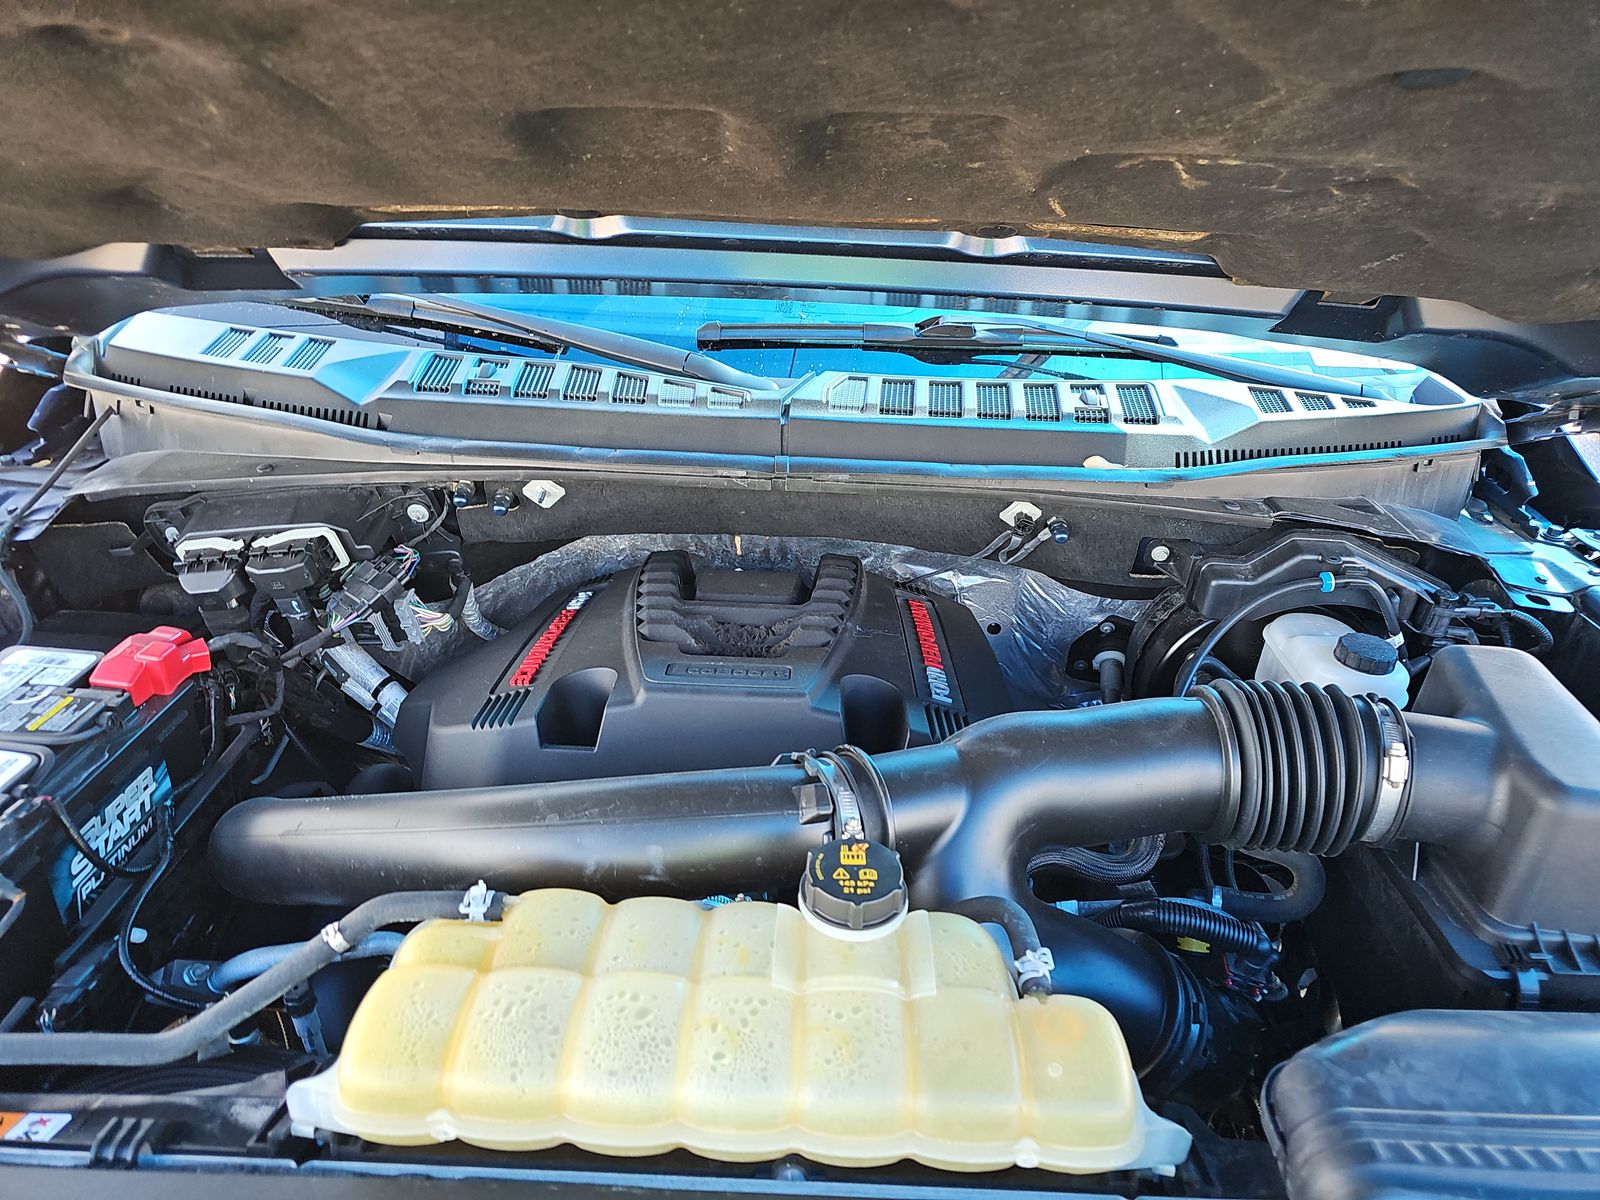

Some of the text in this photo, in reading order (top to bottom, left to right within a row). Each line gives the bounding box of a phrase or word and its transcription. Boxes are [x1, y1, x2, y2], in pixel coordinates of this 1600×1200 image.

[926, 666, 953, 704] FORD
[71, 781, 159, 888] START
[79, 766, 155, 845] SUPER
[81, 816, 153, 901] PLTINUM
